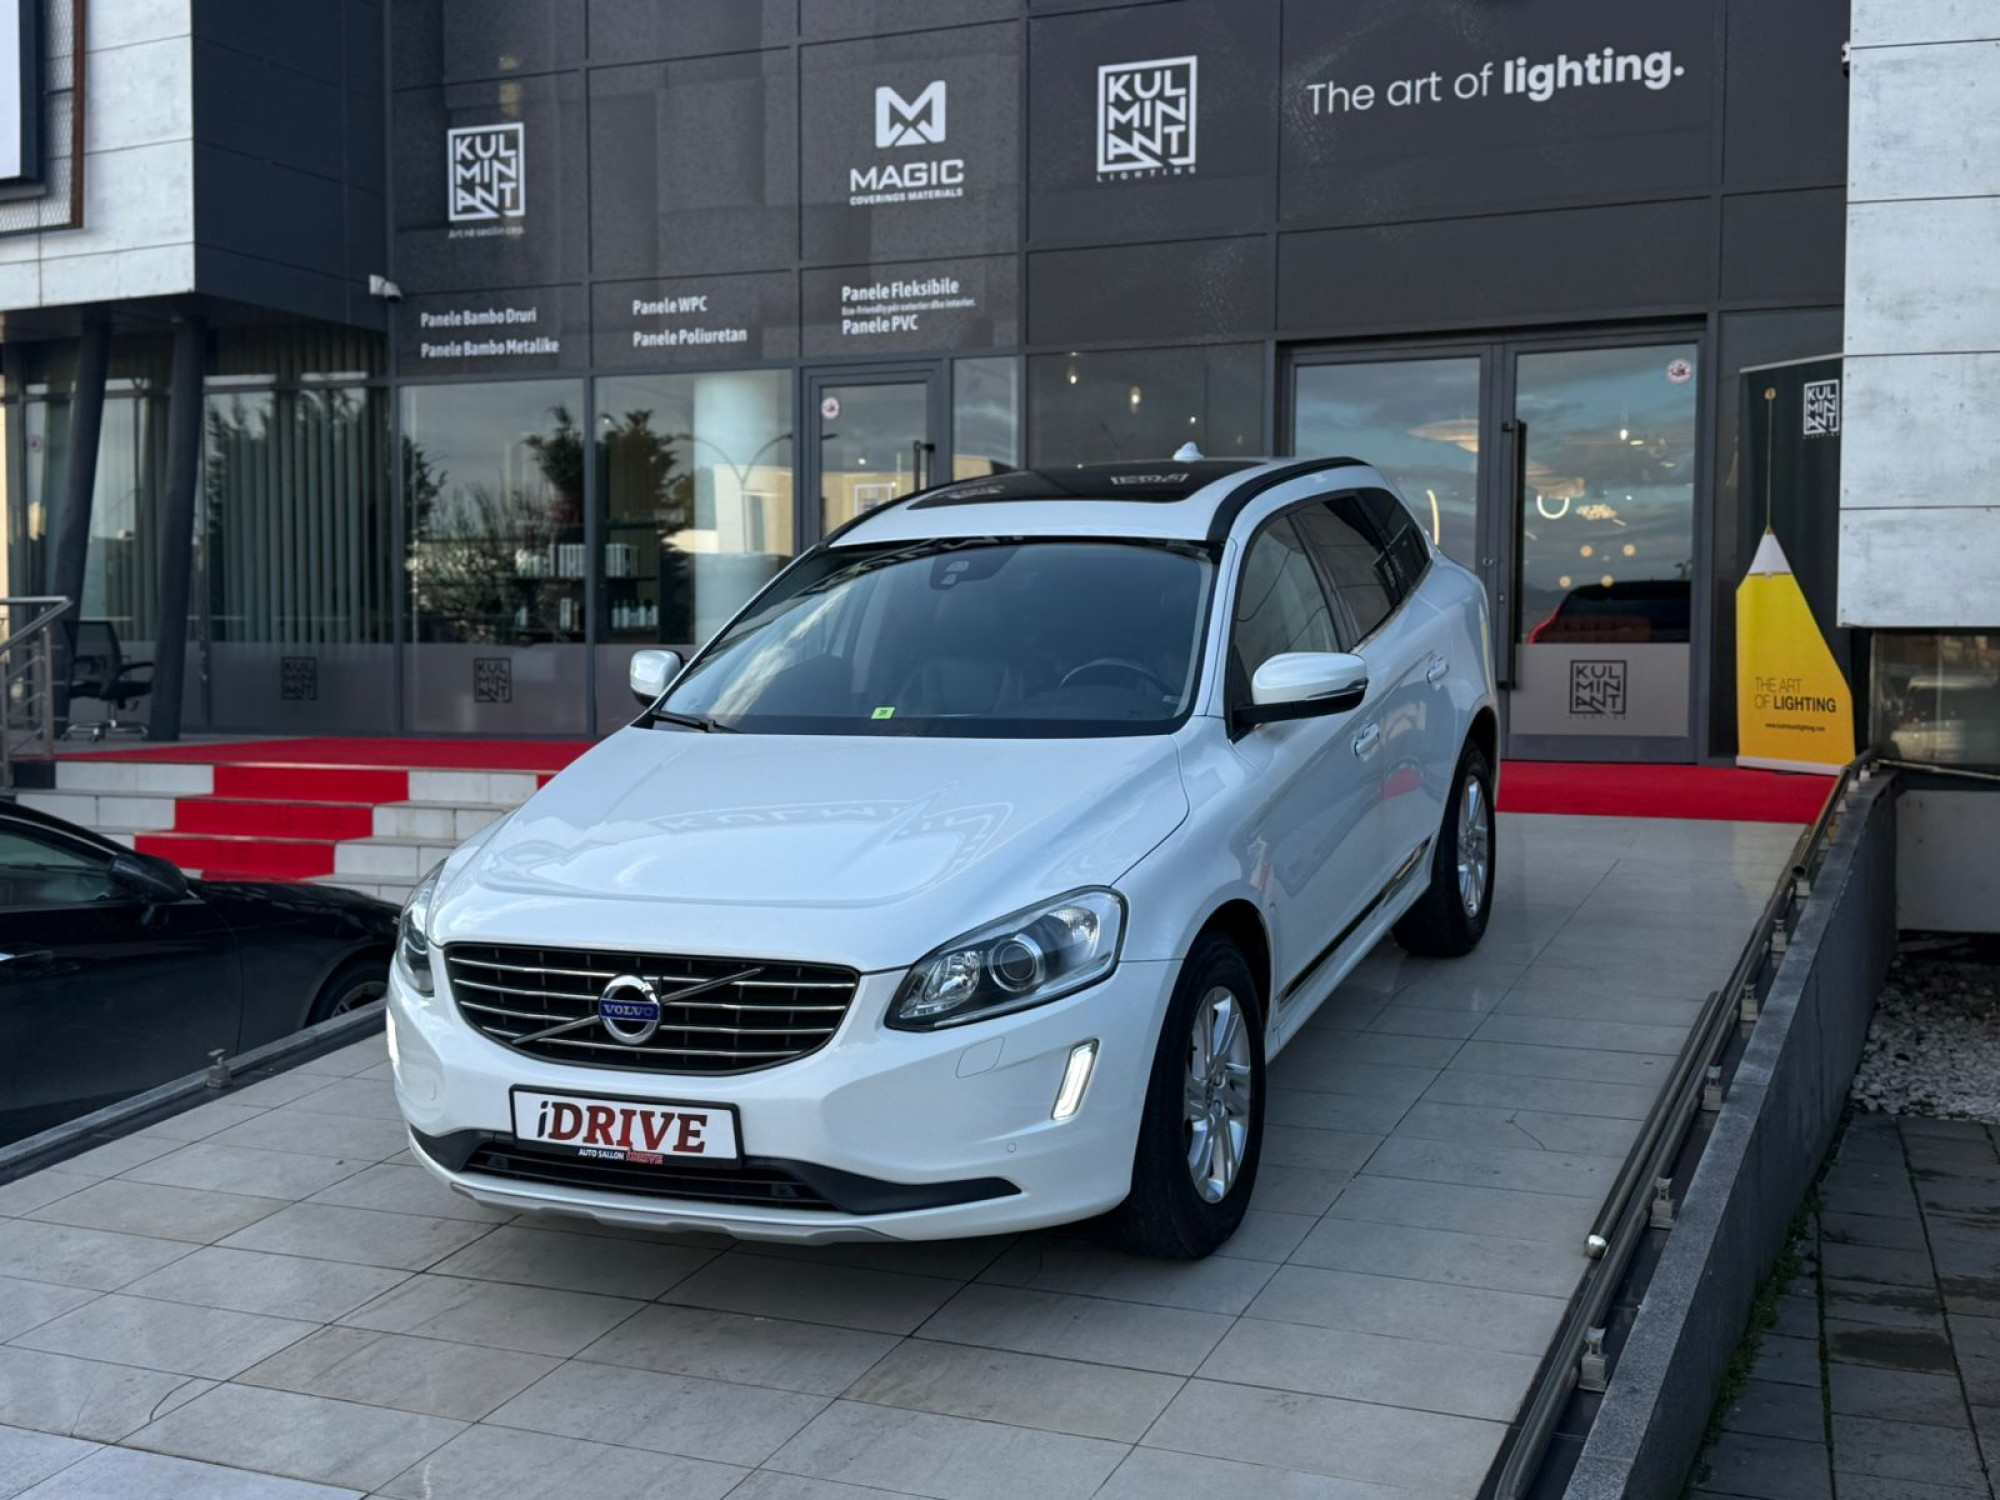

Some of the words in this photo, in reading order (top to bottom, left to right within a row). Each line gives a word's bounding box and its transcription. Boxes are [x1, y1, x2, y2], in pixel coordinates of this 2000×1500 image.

[1306, 81, 1375, 115] The
[1386, 71, 1442, 107] art
[1454, 62, 1494, 99] of
[1503, 47, 1685, 102] lighting.
[849, 159, 964, 192] MAGIC
[907, 188, 963, 201] MATERIALS
[842, 282, 890, 302] Panele
[891, 277, 960, 298] Fleksibile
[632, 297, 677, 316] Panele
[678, 295, 708, 313] WPC
[420, 310, 462, 328] Panele
[463, 307, 504, 326] Bambo
[506, 306, 537, 324] Druri
[842, 316, 890, 335] Panele
[891, 314, 919, 332] PVC
[421, 339, 462, 359] Panele
[463, 338, 505, 356] Bambo
[506, 336, 560, 355] Metalike
[633, 329, 678, 347] Panele
[678, 327, 748, 345] Poliuretan
[1755, 676, 1776, 692] THE
[1779, 678, 1802, 693] ART
[1755, 693, 1771, 709] OF
[1773, 695, 1836, 713] LIGHTING
[537, 1100, 708, 1153] iDRIVE
[578, 1148, 597, 1157] AUTO
[598, 1149, 625, 1160] SALLON
